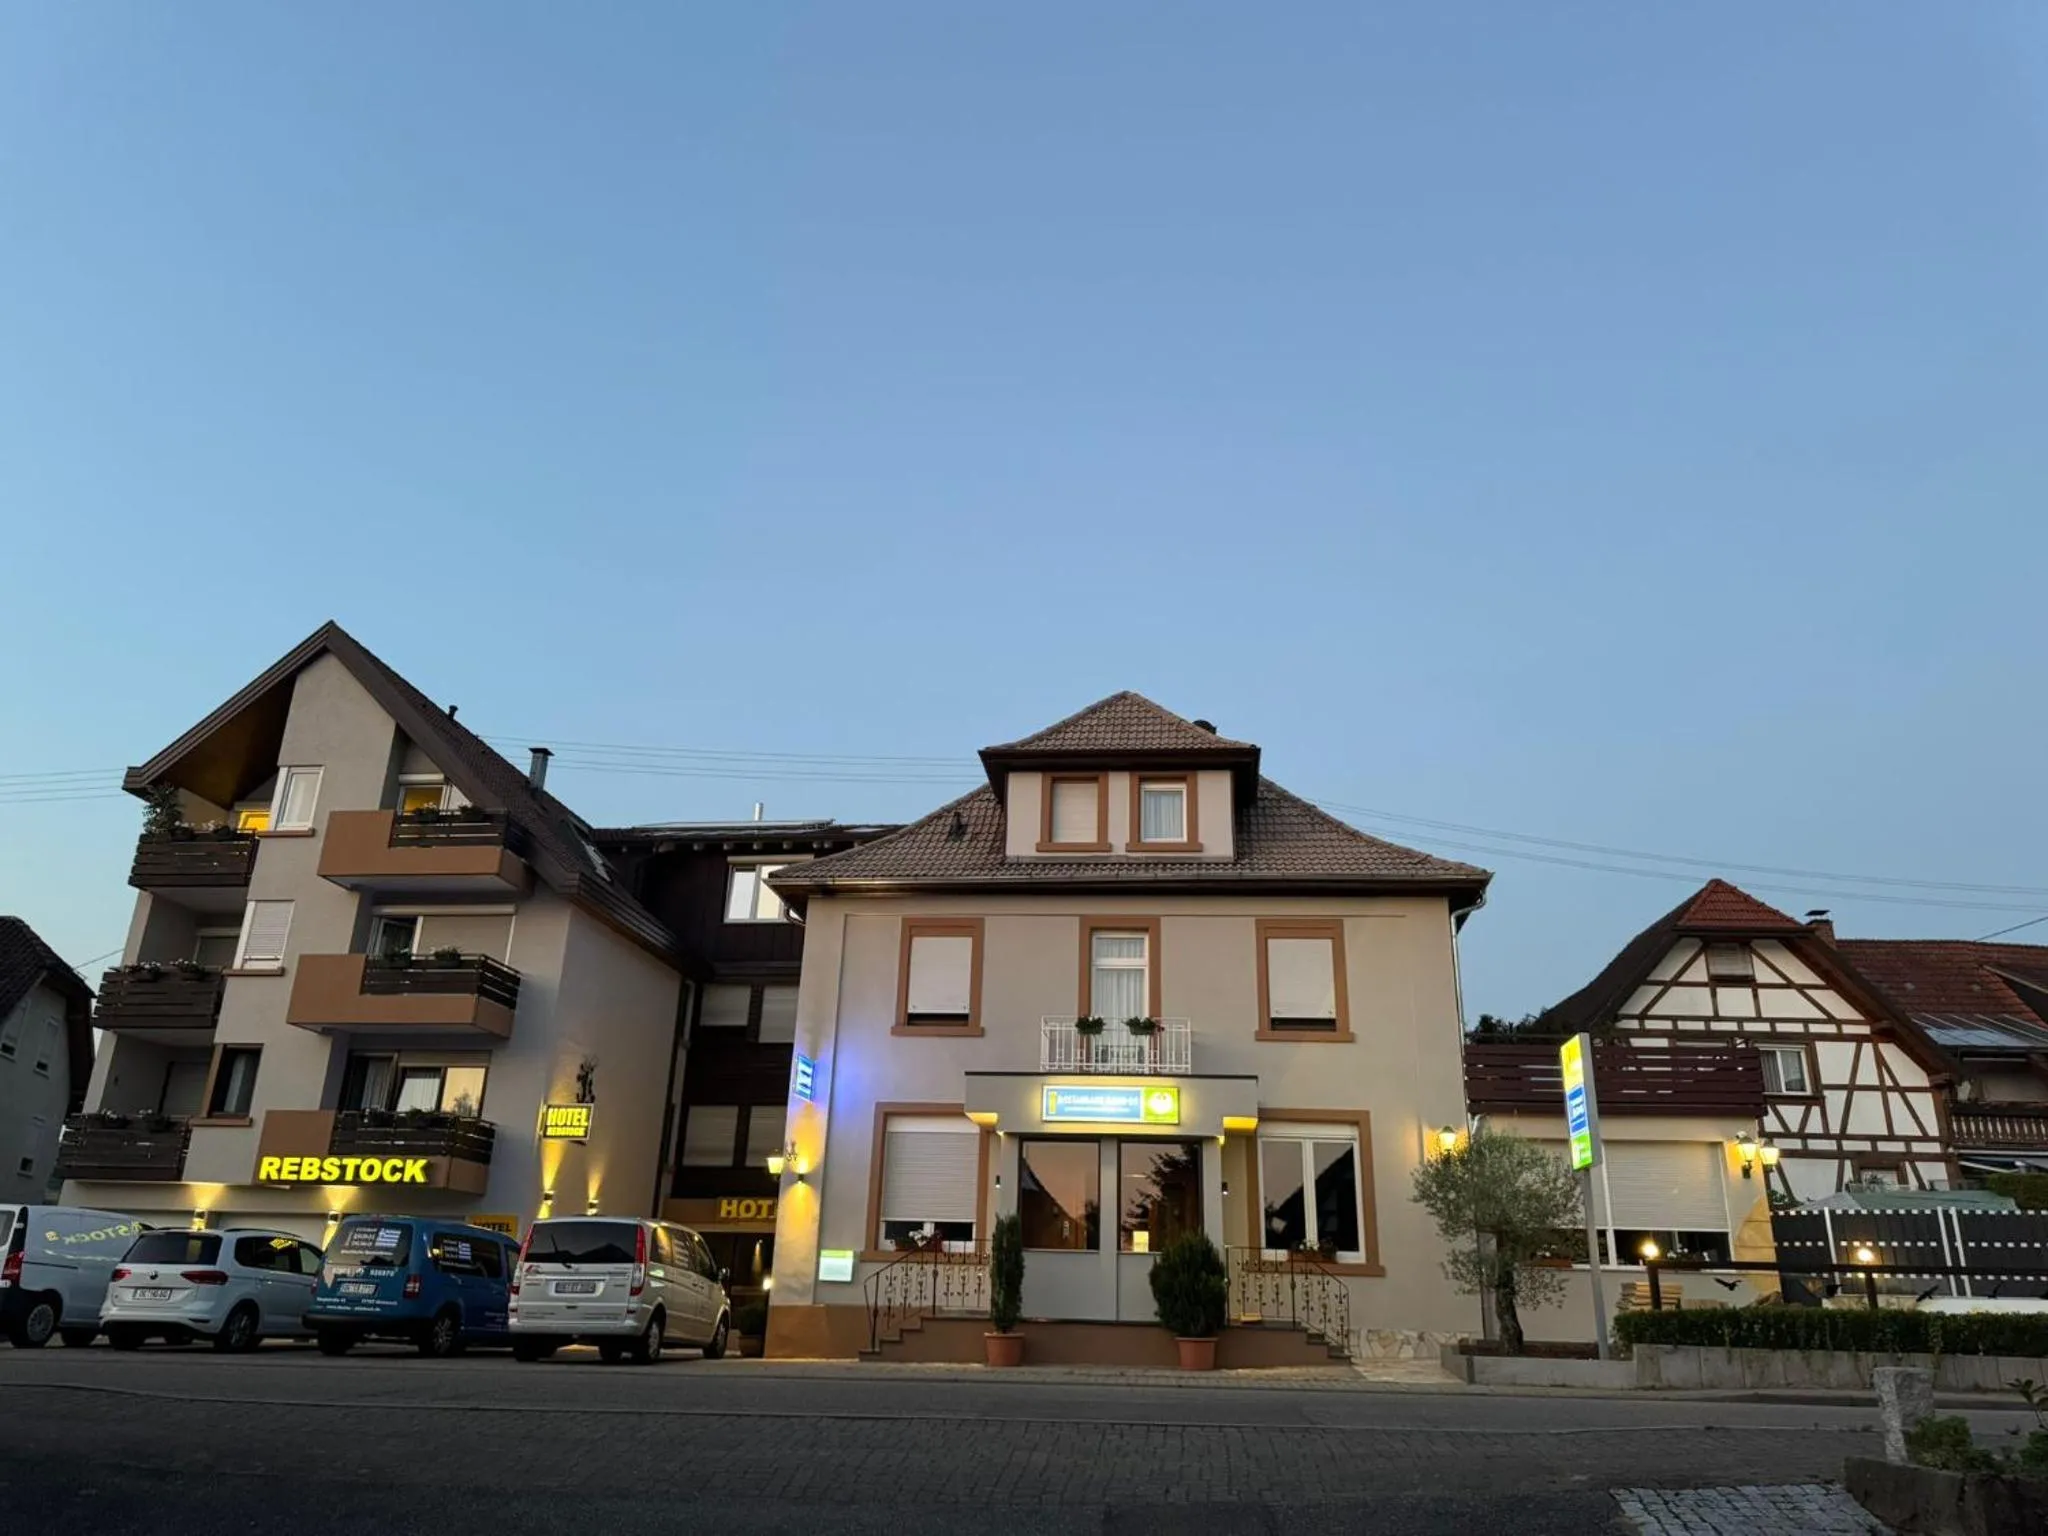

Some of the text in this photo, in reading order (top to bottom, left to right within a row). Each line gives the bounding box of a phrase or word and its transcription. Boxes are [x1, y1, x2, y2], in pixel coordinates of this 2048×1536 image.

[547, 1107, 588, 1126] HOTEL
[258, 1155, 429, 1184] REBSTOCK
[720, 1199, 777, 1219] HOT
